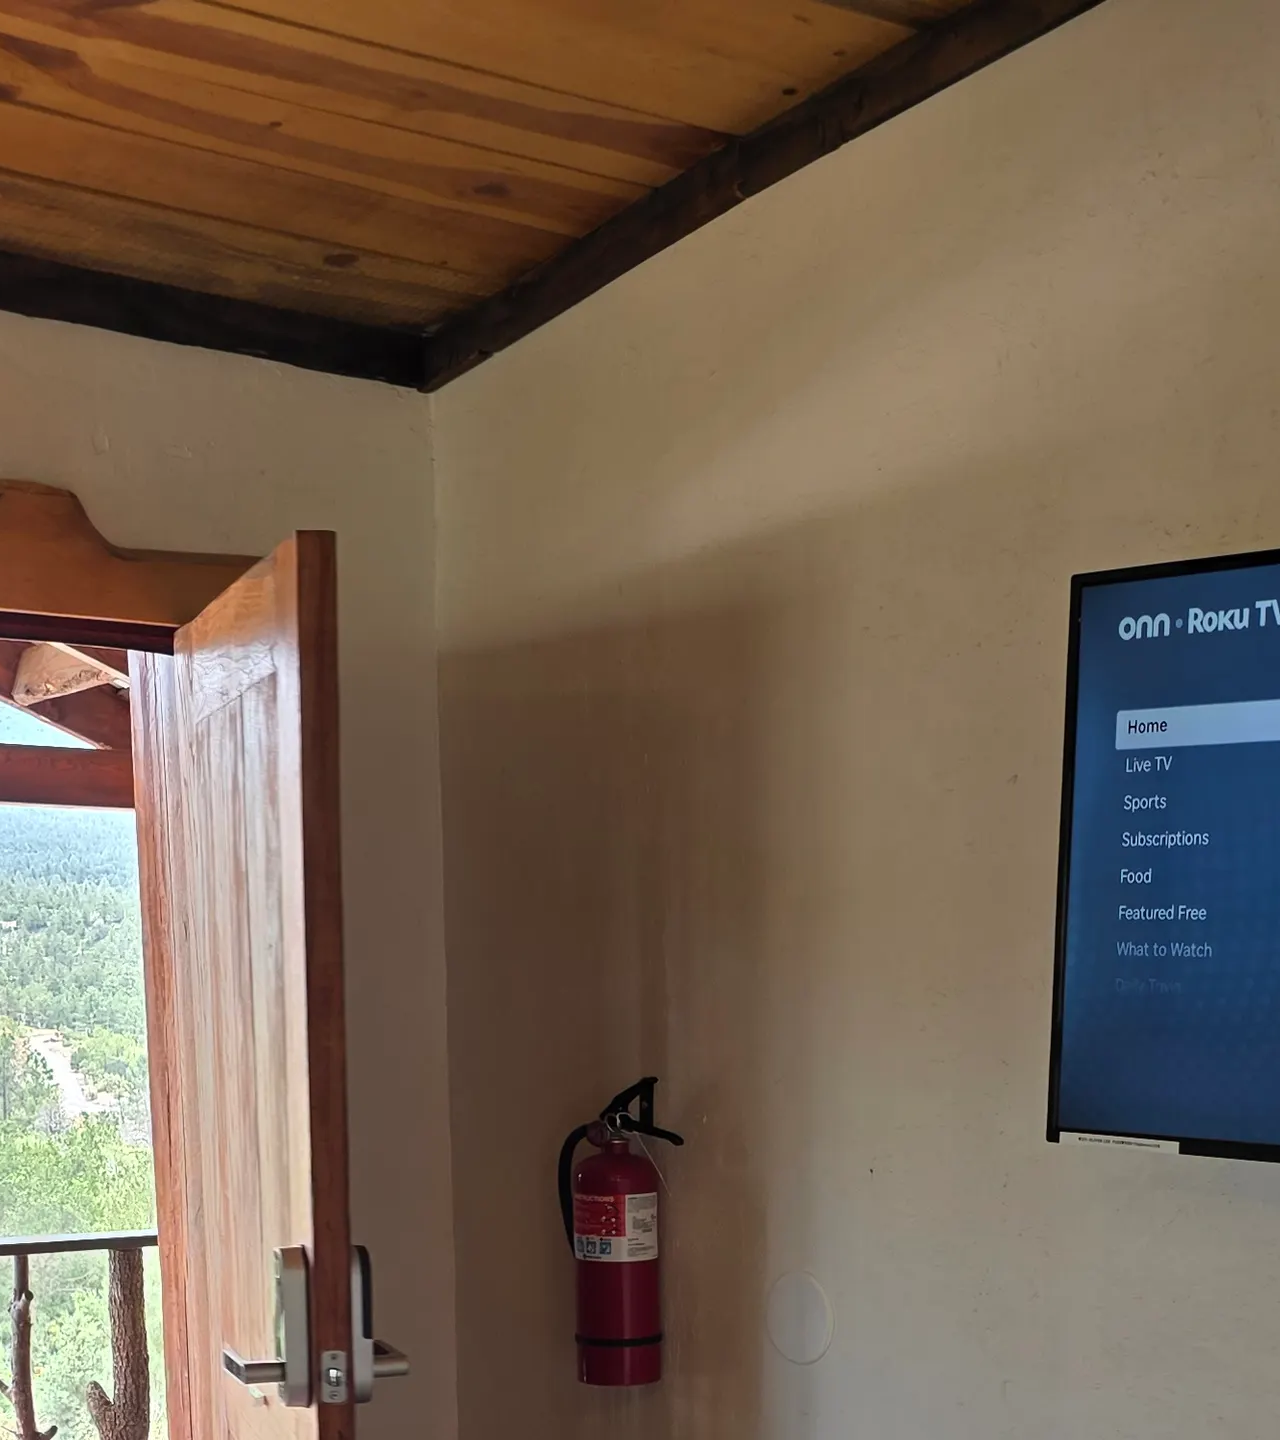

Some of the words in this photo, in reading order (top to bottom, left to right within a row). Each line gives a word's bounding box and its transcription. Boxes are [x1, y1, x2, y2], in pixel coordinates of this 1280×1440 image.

[1118, 612, 1171, 641] onn
[1187, 607, 1251, 635] Roku
[1127, 719, 1169, 735] Home
[1125, 758, 1152, 773] Live
[1155, 755, 1173, 773] TV
[1123, 794, 1168, 813] Sports
[1121, 830, 1210, 849] Subscriptions
[1120, 868, 1153, 884] Food
[1118, 905, 1175, 921] Featured
[1178, 905, 1208, 921] Free
[1116, 941, 1150, 957] What
[1152, 942, 1168, 957] to
[1170, 942, 1213, 958] Watch
